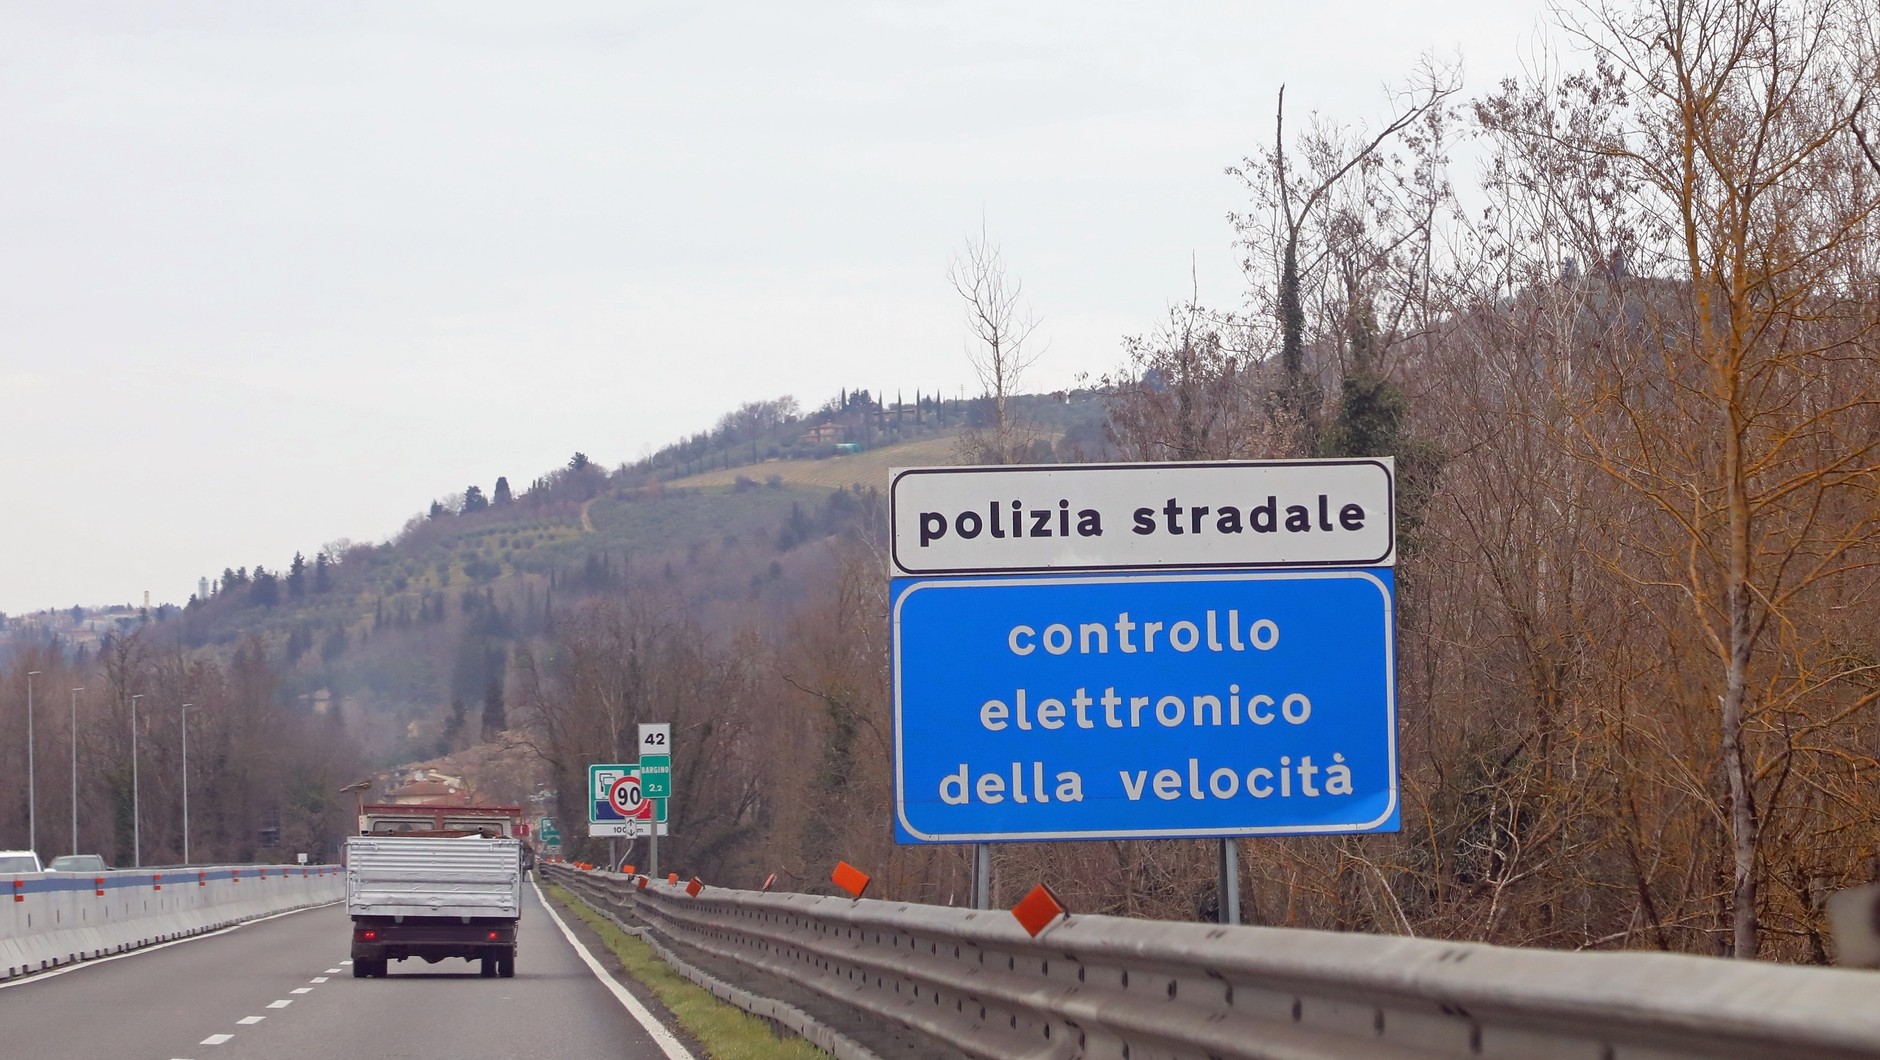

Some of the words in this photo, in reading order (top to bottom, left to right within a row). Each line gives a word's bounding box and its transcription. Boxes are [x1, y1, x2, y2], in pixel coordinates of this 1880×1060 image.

[919, 500, 1104, 547] polizia
[1131, 494, 1366, 536] stradale
[1008, 609, 1280, 656] controllo
[979, 684, 1312, 731] elettronico
[644, 733, 665, 746] 42
[641, 766, 669, 774] BARGINO
[938, 761, 1085, 805] della
[1119, 752, 1354, 802] velocità
[617, 786, 640, 806] 90
